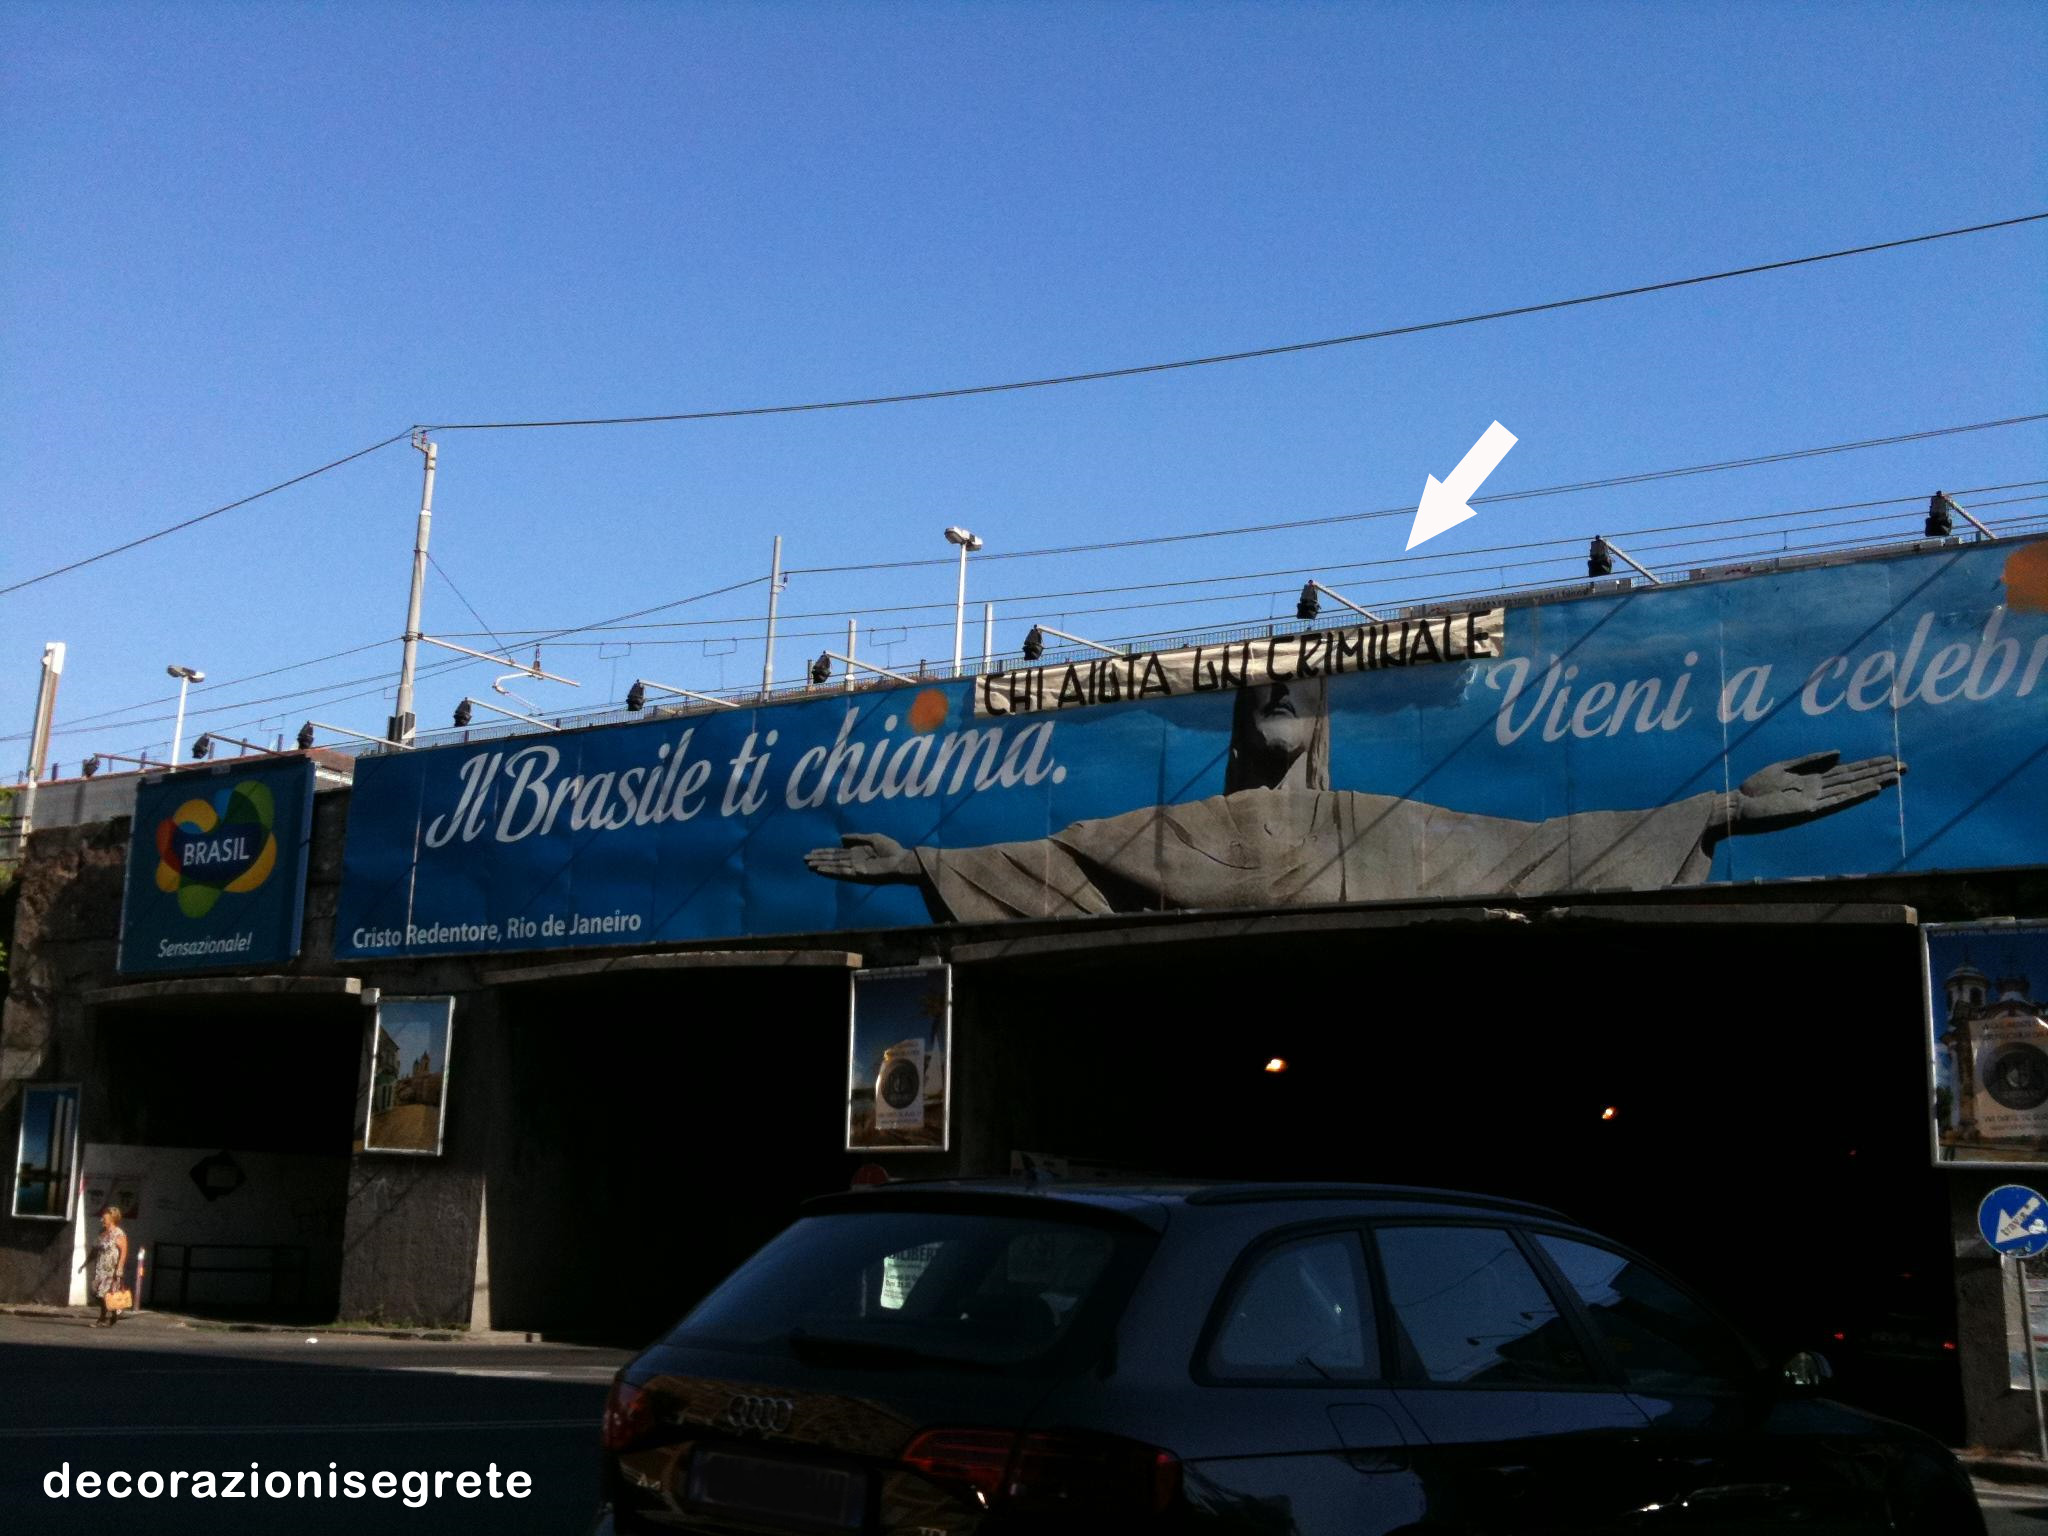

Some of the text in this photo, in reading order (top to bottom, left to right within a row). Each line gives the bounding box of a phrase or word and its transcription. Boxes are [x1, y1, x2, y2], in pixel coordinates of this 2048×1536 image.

[984, 609, 1492, 715] CHI AIUTA UN CRIMINALE
[1485, 651, 1697, 746] Vieni
[1717, 662, 1774, 724] a
[425, 706, 1067, 848] Il Brasile ti chiama.
[183, 837, 250, 867] BRASIL
[157, 931, 253, 958] Sensazionale!
[352, 909, 642, 949] Cristo Redentore, Rio de Janeiro
